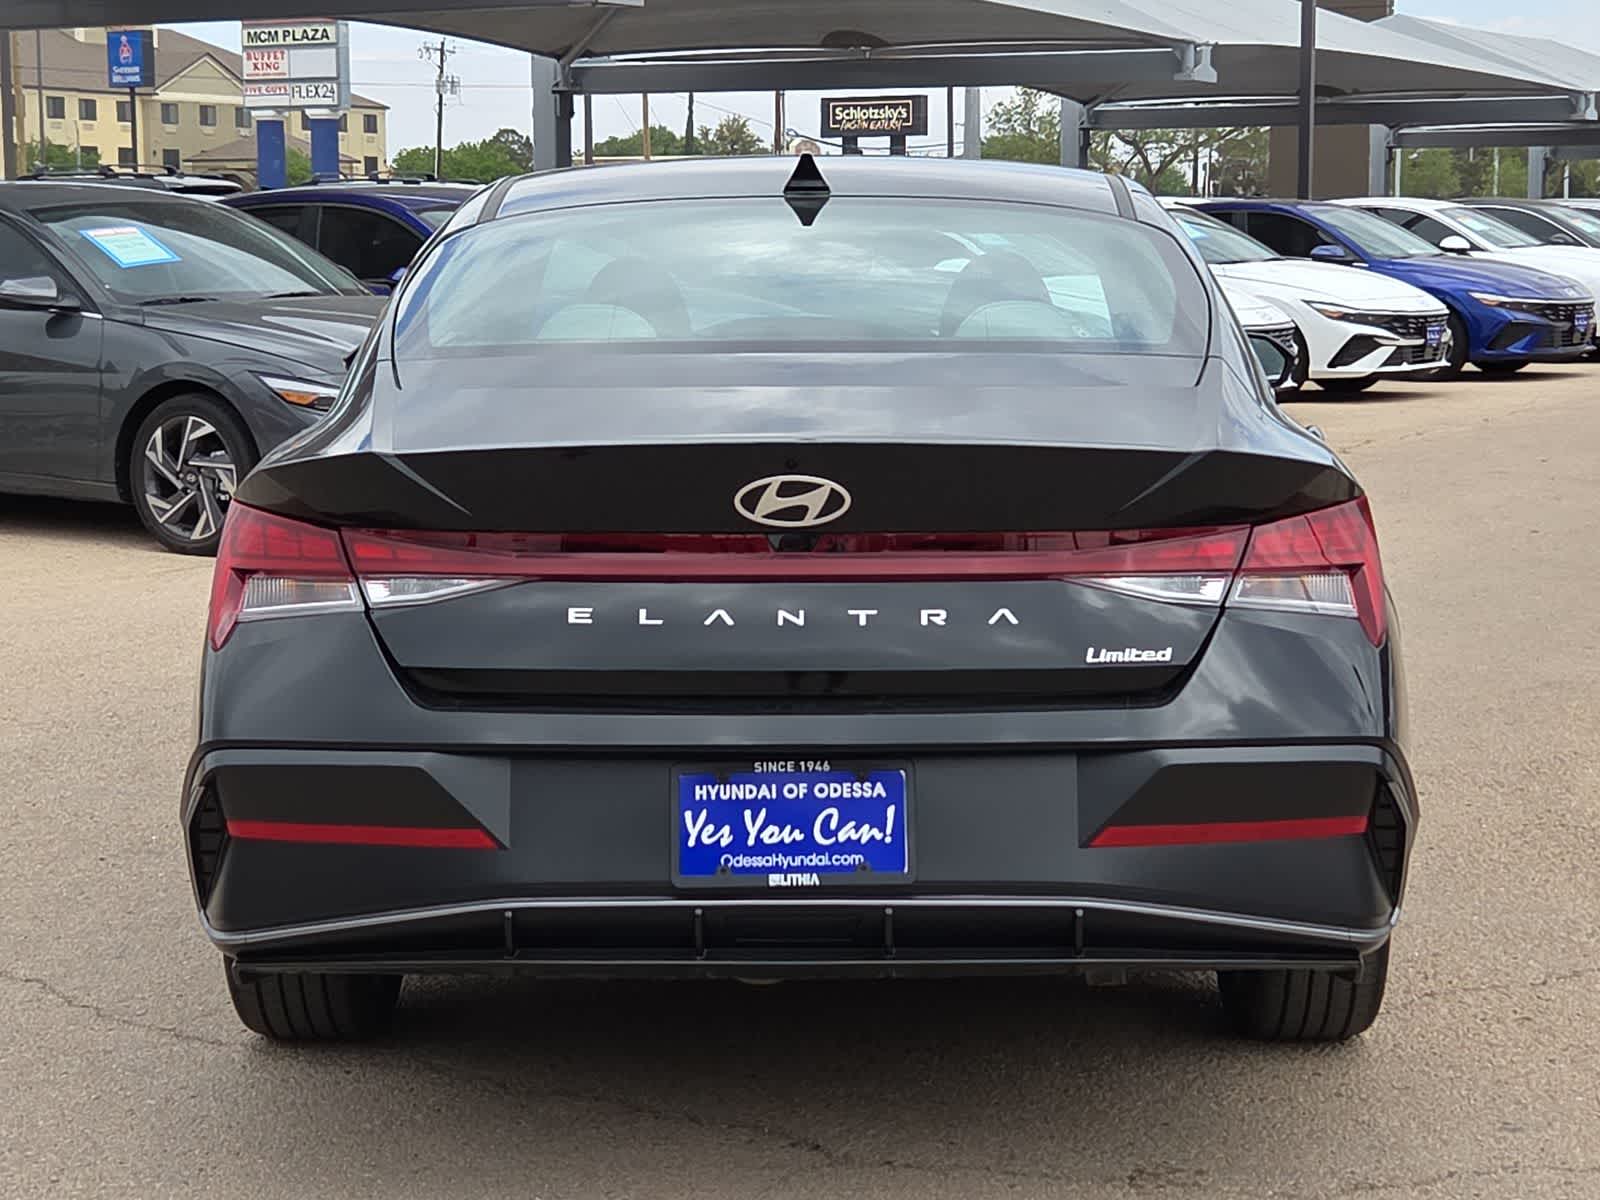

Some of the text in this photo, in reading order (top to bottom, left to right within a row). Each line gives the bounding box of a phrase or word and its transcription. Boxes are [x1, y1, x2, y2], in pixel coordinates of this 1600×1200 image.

[247, 28, 330, 43] MCM PLAZA
[246, 50, 285, 61] BUFFET
[252, 62, 280, 71] KING
[835, 105, 907, 120] Schlotzsky's
[567, 607, 1019, 627] ELANTRA
[1086, 647, 1173, 664] Limited
[753, 760, 831, 773] SINCE 1946
[694, 781, 887, 801] HYUNDAI OF ODESSA
[683, 804, 897, 848] Yes You Can!
[720, 853, 865, 870] OdessaHyundai.com
[781, 873, 820, 887] LITHIA
